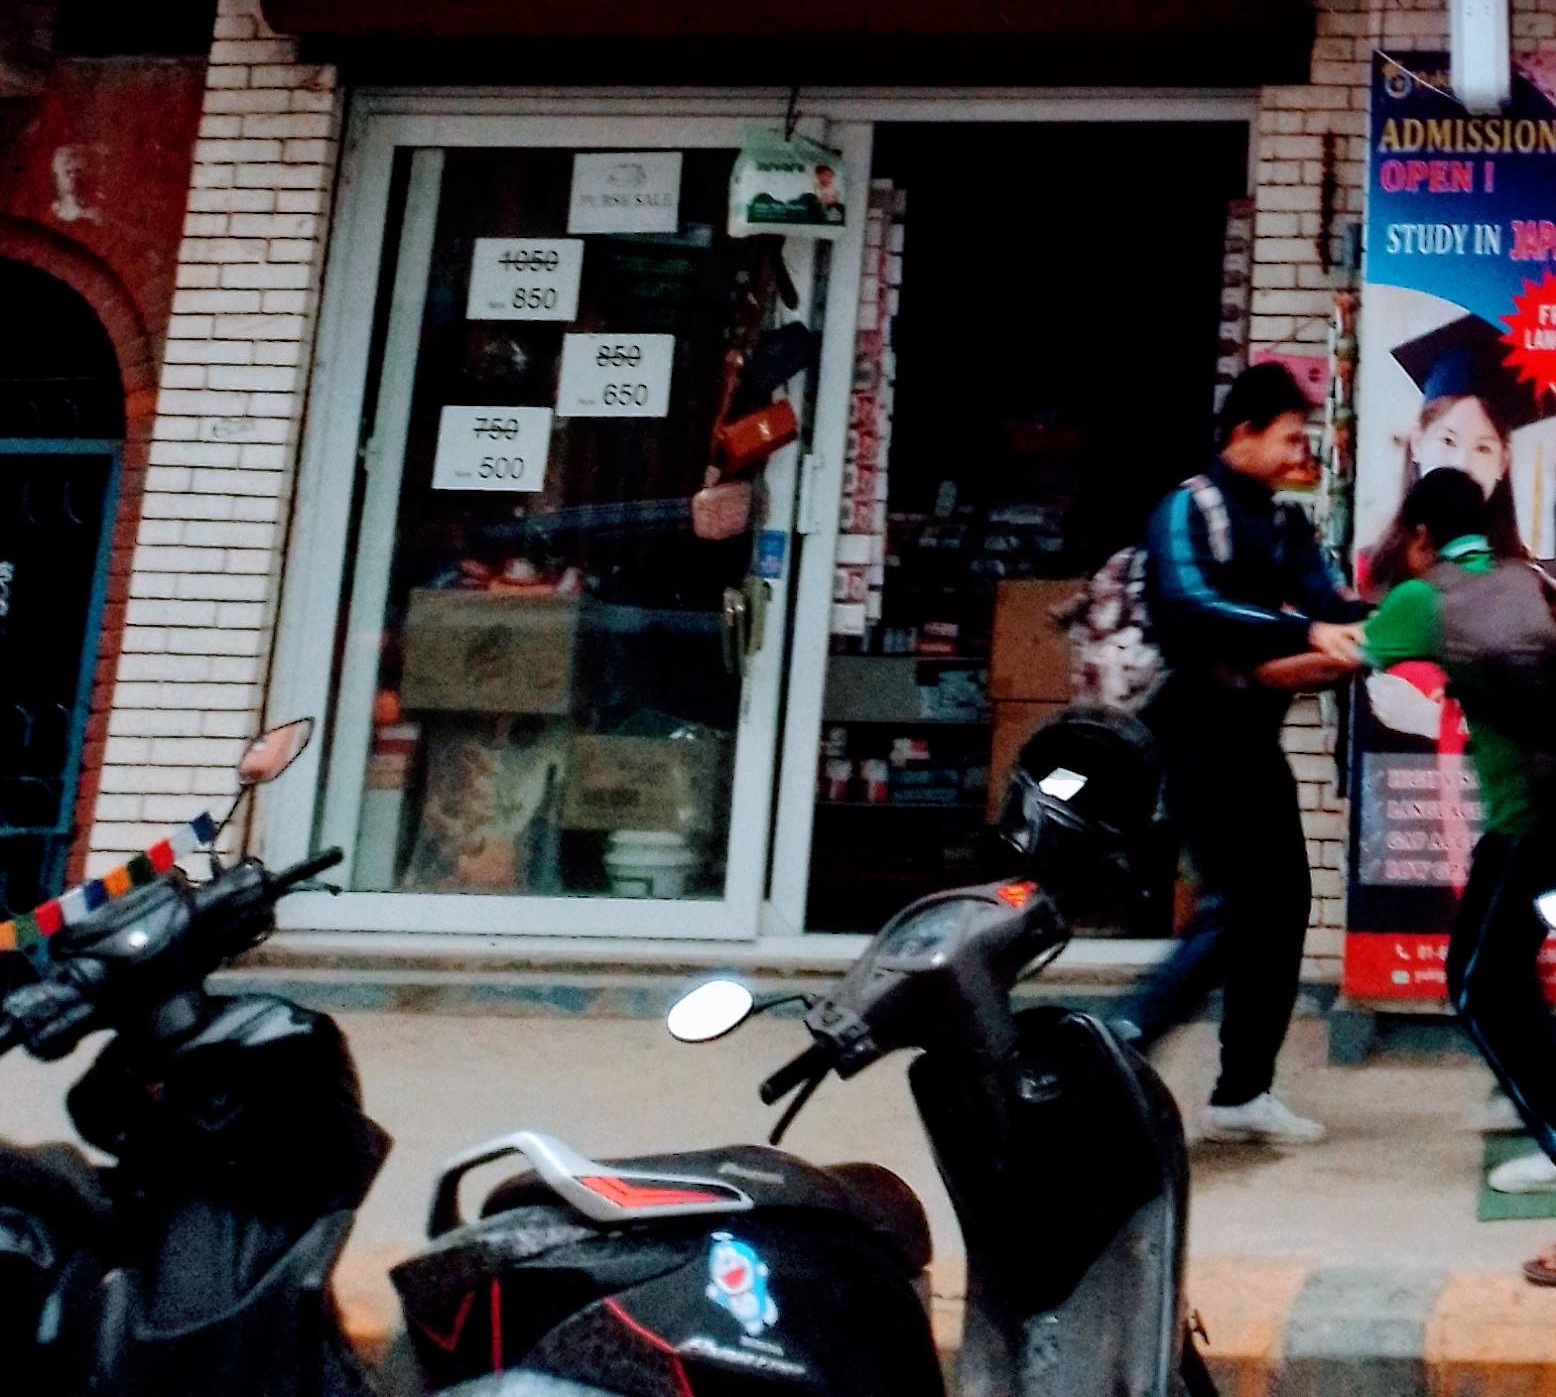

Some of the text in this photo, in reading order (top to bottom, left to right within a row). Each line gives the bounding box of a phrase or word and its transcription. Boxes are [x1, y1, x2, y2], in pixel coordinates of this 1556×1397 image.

[1379, 158, 1475, 194] OPEN
[1386, 222, 1469, 256] STUDY
[1473, 223, 1502, 256] IN
[511, 287, 559, 310] 850
[602, 383, 649, 407] 650
[477, 457, 525, 480] 500
